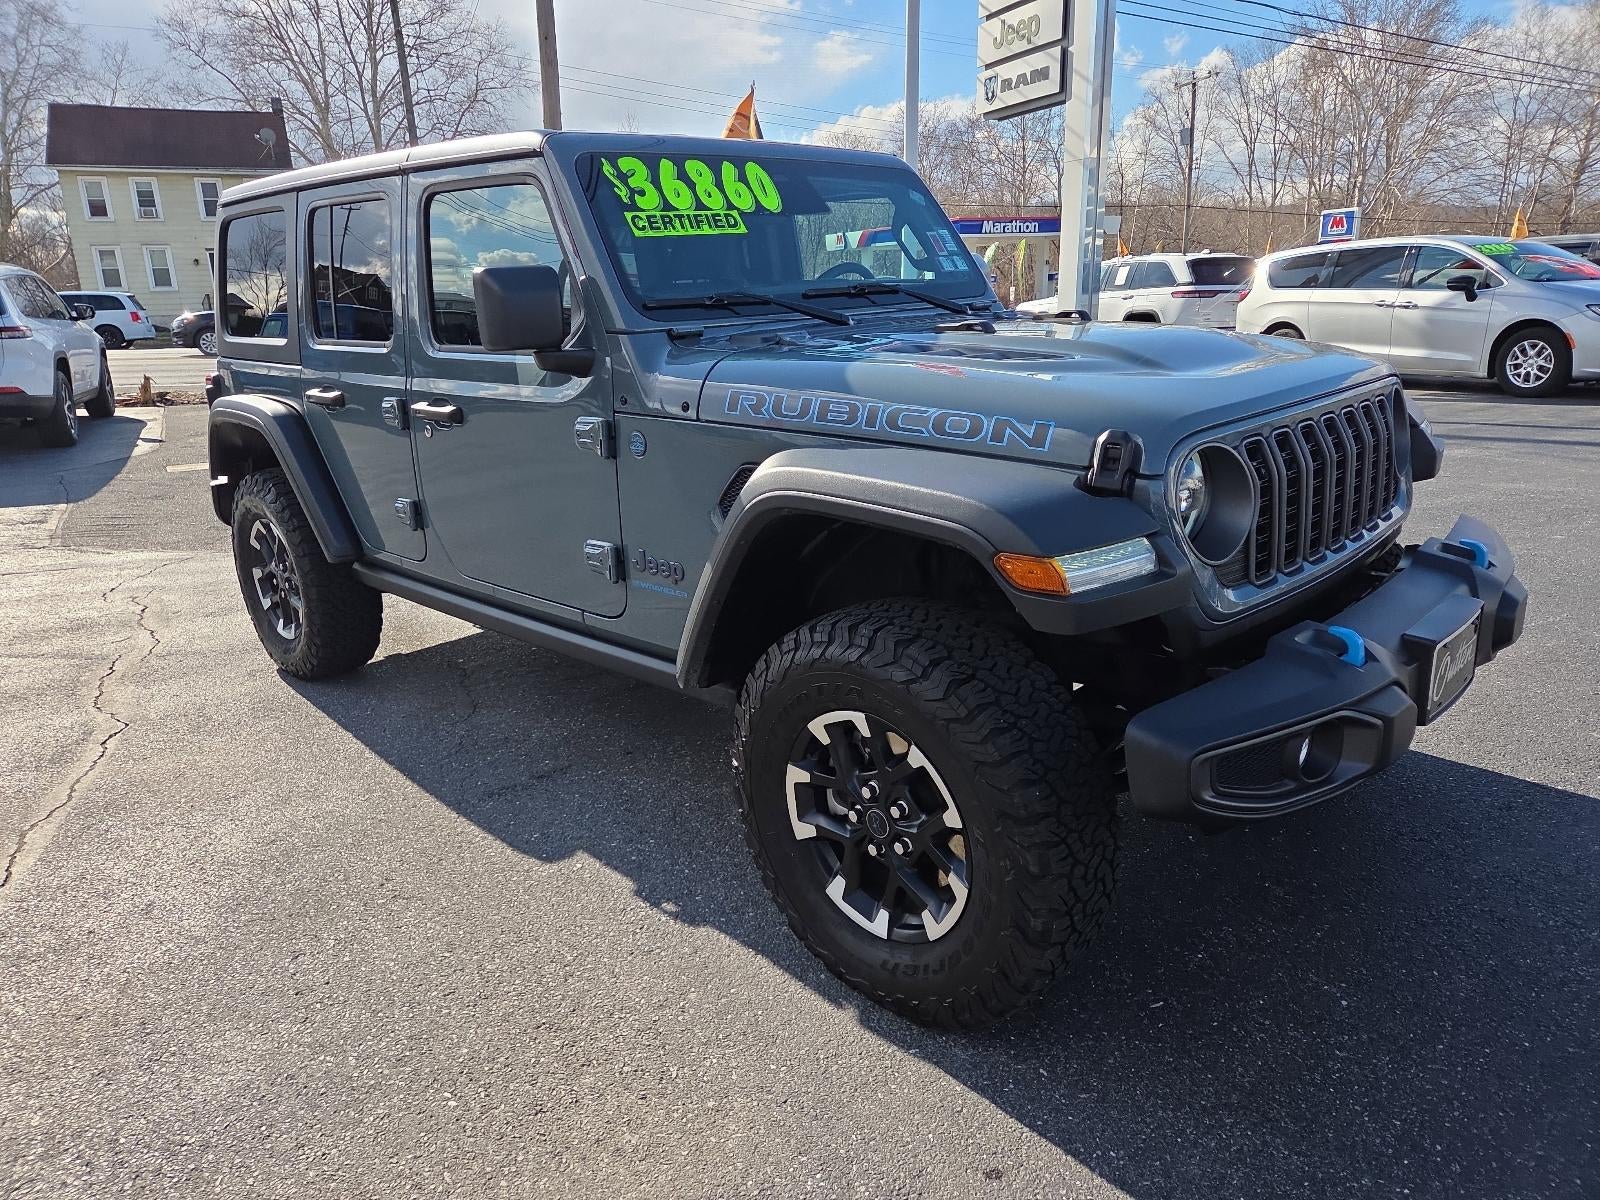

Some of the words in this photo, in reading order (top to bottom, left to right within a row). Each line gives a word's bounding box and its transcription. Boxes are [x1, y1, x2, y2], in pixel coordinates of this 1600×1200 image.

[993, 14, 1041, 50] Jeep
[1000, 65, 1050, 93] RAM
[601, 156, 782, 213] $36860
[630, 212, 741, 233] CERTIFIED
[982, 221, 1039, 233] Marathon
[724, 389, 1056, 452] RUBICON
[632, 548, 685, 585] Jeep
